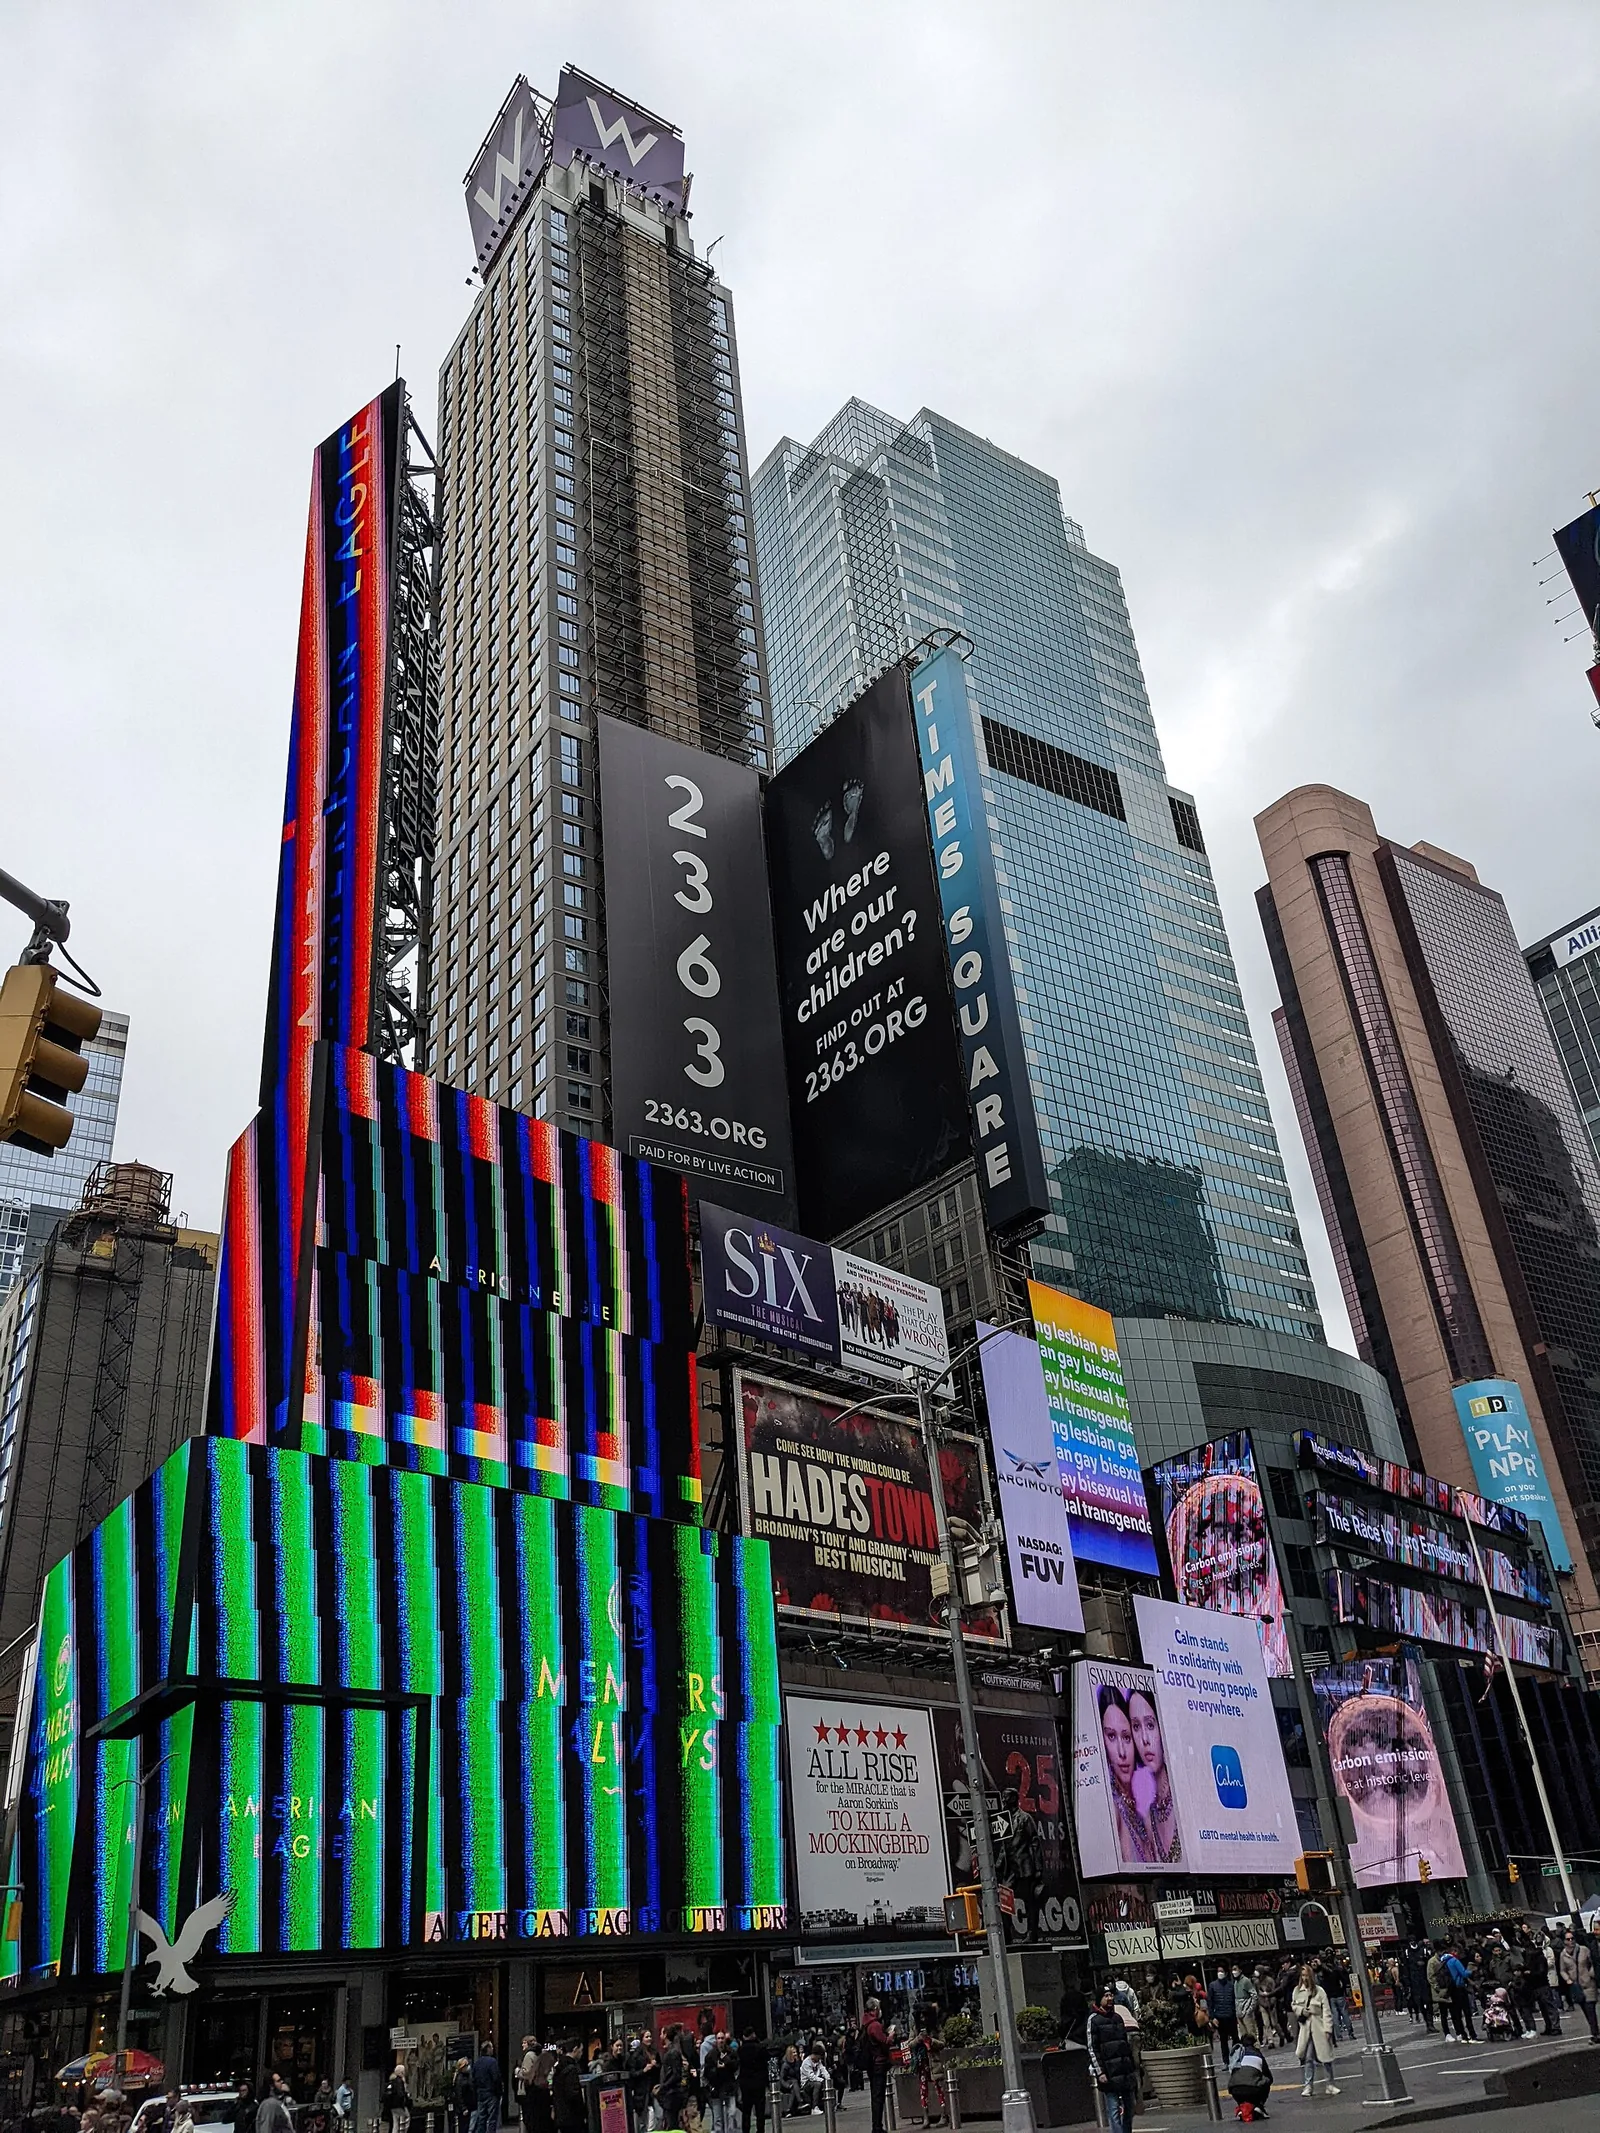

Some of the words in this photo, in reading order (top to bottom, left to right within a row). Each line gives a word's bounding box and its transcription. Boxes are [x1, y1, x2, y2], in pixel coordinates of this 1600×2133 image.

[586, 96, 659, 168] W
[803, 850, 891, 935] Where
[805, 930, 847, 976] are
[849, 886, 898, 933] our
[917, 680, 965, 880] TIMES
[948, 906, 1013, 1189] SQUARE
[797, 909, 919, 1024] children?
[815, 1020, 848, 1056] FIND
[850, 1001, 883, 1034] OUT
[884, 977, 906, 1009] AT
[805, 994, 928, 1104] 2363.ORG
[644, 1098, 768, 1151] 2363.ORG
[638, 1142, 666, 1160] PAID
[668, 1149, 691, 1167] FOR
[692, 1154, 707, 1171] BY
[707, 1158, 732, 1177] LIVE
[733, 1162, 776, 1186] ACTION
[724, 1227, 824, 1324] SIX
[846, 1268, 859, 1278] AND
[858, 1273, 896, 1293] INTERNATIONAL
[896, 1287, 928, 1304] PHENOMENON
[751, 1303, 766, 1320] THE
[769, 1310, 804, 1333] MUSICAL
[901, 1314, 918, 1328] THAT
[919, 1320, 944, 1340] GOES
[902, 1304, 916, 1317] THE
[917, 1307, 938, 1325] PLAY
[901, 1326, 946, 1357] WRONG
[1051, 1319, 1098, 1356] lesbian
[855, 1347, 867, 1357] NEW
[867, 1350, 885, 1362] WORLD
[884, 1356, 902, 1368] STAGES
[1040, 1344, 1057, 1362] an
[1058, 1351, 1082, 1376] gay
[1045, 1369, 1061, 1390] ay
[1061, 1368, 1113, 1407] bisexual
[1069, 1418, 1117, 1455] lesbian
[776, 1437, 801, 1457] COME
[801, 1443, 816, 1460] SEE
[816, 1446, 835, 1465] HOW
[834, 1451, 851, 1469] THE
[850, 1456, 878, 1475] WORLD
[877, 1463, 901, 1481] COULD
[902, 1469, 914, 1485] BE.
[1056, 1444, 1073, 1463] an
[1074, 1450, 1098, 1475] gay
[1336, 1450, 1360, 1471] Stanley
[998, 1472, 1063, 1498] ARCIMOTO
[1060, 1470, 1076, 1491] ay
[1076, 1467, 1131, 1505] bisexual
[1494, 1494, 1519, 1505] mart
[1504, 1484, 1518, 1493] on
[1519, 1483, 1536, 1493] your
[755, 1518, 820, 1544] BROADWAY'S
[848, 1536, 868, 1554] AND
[1017, 1534, 1063, 1556] NASDAQ:
[1325, 1506, 1350, 1533] The
[1350, 1513, 1382, 1543] Race
[1382, 1523, 1394, 1545] to
[1420, 1534, 1470, 1568] Emissions
[814, 1545, 848, 1571] BEST
[849, 1551, 907, 1582] MUSICAL
[1019, 1552, 1065, 1587] FUV
[1184, 1553, 1217, 1575] Carbon
[1217, 1540, 1262, 1563] emissions
[1203, 1575, 1212, 1585] at
[1212, 1567, 1239, 1583] historic
[1174, 1627, 1199, 1648] Calm
[1199, 1632, 1230, 1653] stands
[1167, 1649, 1178, 1664] in
[1179, 1651, 1222, 1677] solidarity
[1222, 1657, 1243, 1676] with
[986, 1675, 1020, 1688] OUTFRONT
[1022, 1680, 1041, 1690] PRIME
[1089, 1666, 1158, 1695] SWAROVSKI
[1162, 1669, 1197, 1691] LGBTQ
[1197, 1678, 1226, 1700] young
[1226, 1680, 1258, 1700] people
[1187, 1698, 1245, 1719] everywhere.
[1000, 1733, 1053, 1747] CELEBRATING
[862, 1751, 920, 1784] RISE
[1332, 1752, 1372, 1773] Carbon
[1375, 1747, 1435, 1765] emissions
[815, 1780, 829, 1794] for
[830, 1782, 845, 1795] the
[845, 1782, 889, 1797] MIRACLE
[889, 1784, 907, 1797] that
[908, 1785, 916, 1798] is
[1005, 1751, 1060, 1815] 25
[1215, 1763, 1244, 1788] Calm
[1353, 1778, 1365, 1789] at
[1366, 1771, 1409, 1788] historic
[837, 1796, 863, 1809] Aaron
[865, 1797, 899, 1811] Sorkin's
[953, 1799, 969, 1810] ONE
[857, 1812, 897, 1833] KILL
[901, 1815, 912, 1832] A
[1036, 1820, 1066, 1841] ARS
[1199, 1828, 1219, 1841] LGBTQ
[1219, 1831, 1239, 1841] mental
[1238, 1832, 1257, 1842] health
[1256, 1833, 1262, 1842] is
[1262, 1832, 1280, 1842] health.
[845, 1859, 857, 1870] on
[1196, 1890, 1215, 1904] FIN
[1107, 1929, 1204, 1958] SWAROVSKI
[1203, 1922, 1278, 1951] SWAROVSKI
[873, 1969, 926, 1993] GRAND
